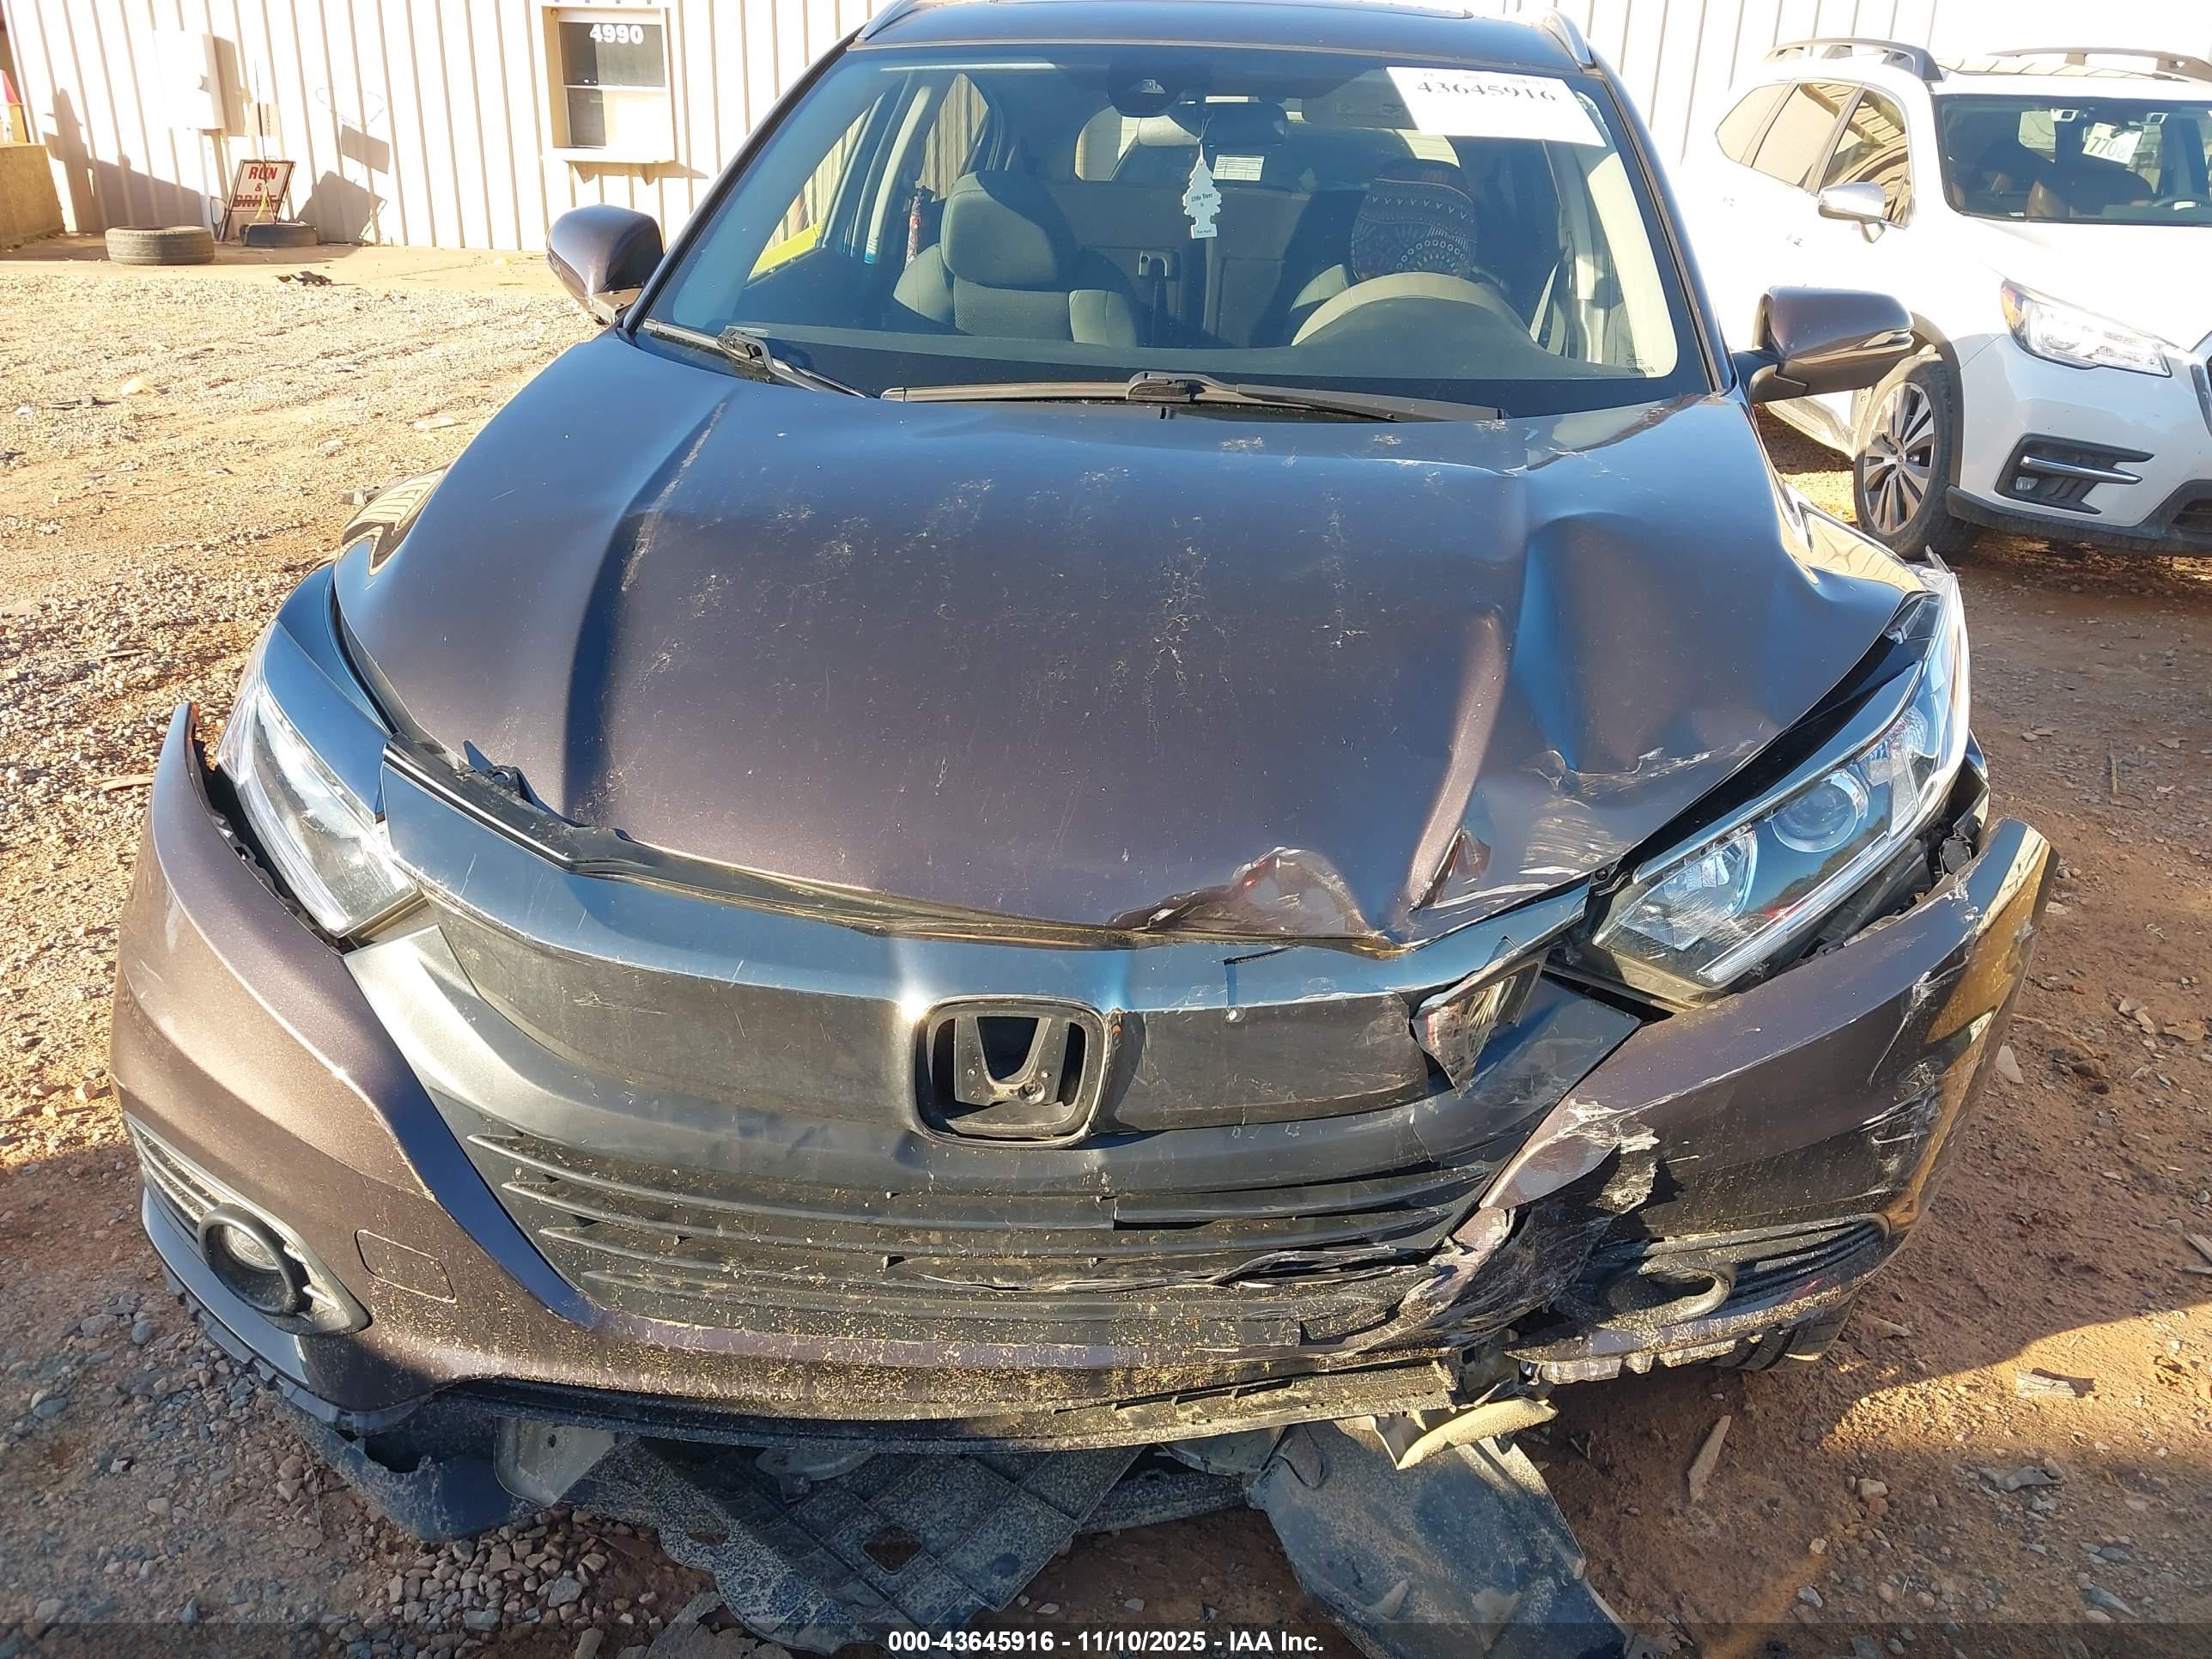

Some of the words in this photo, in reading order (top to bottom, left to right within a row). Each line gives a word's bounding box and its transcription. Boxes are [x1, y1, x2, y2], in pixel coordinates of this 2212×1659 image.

[590, 24, 644, 44] 4990
[1417, 82, 1557, 101] 43645916
[2088, 137, 2130, 160] 7708
[248, 166, 277, 179] RUN
[254, 182, 262, 191] &
